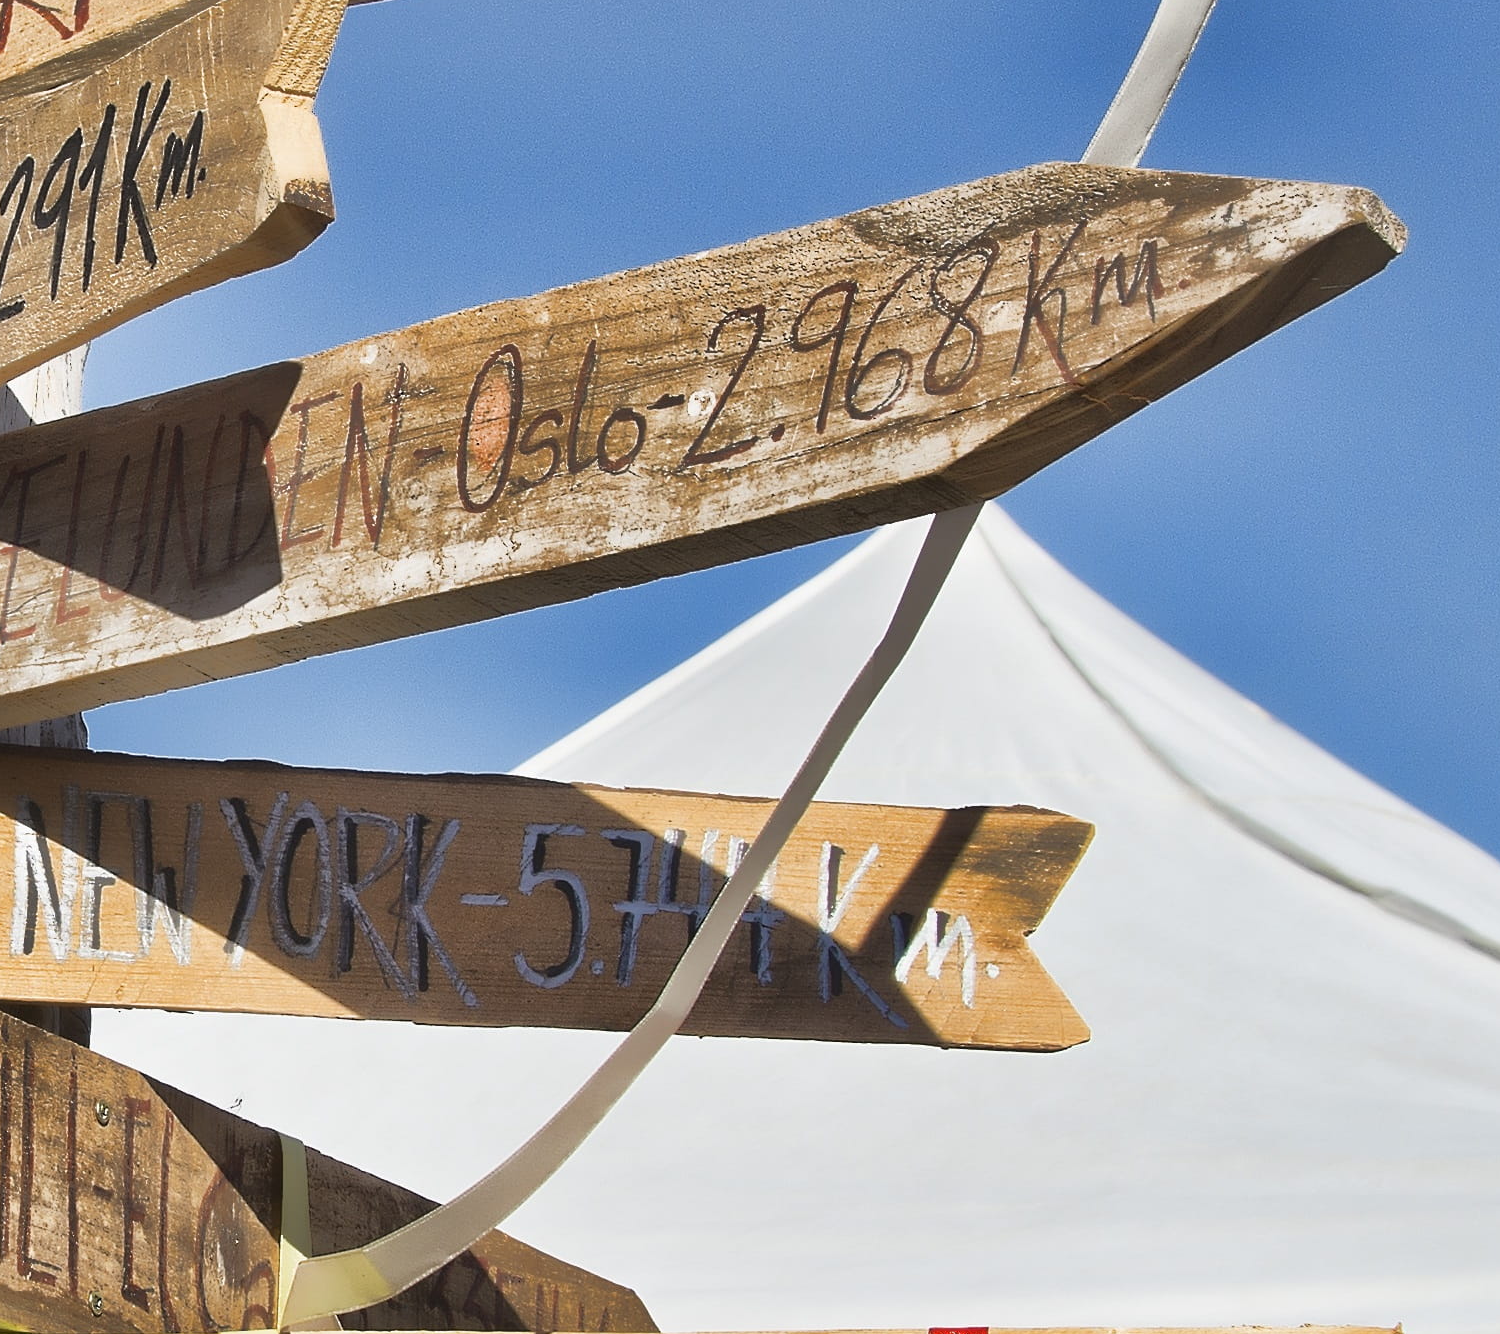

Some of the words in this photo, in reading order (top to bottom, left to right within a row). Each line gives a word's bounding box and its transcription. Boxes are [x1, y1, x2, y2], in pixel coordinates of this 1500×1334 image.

[455, 340, 647, 514] Oslo
[9, 784, 202, 967] NEW
[218, 789, 480, 1008] YORK
